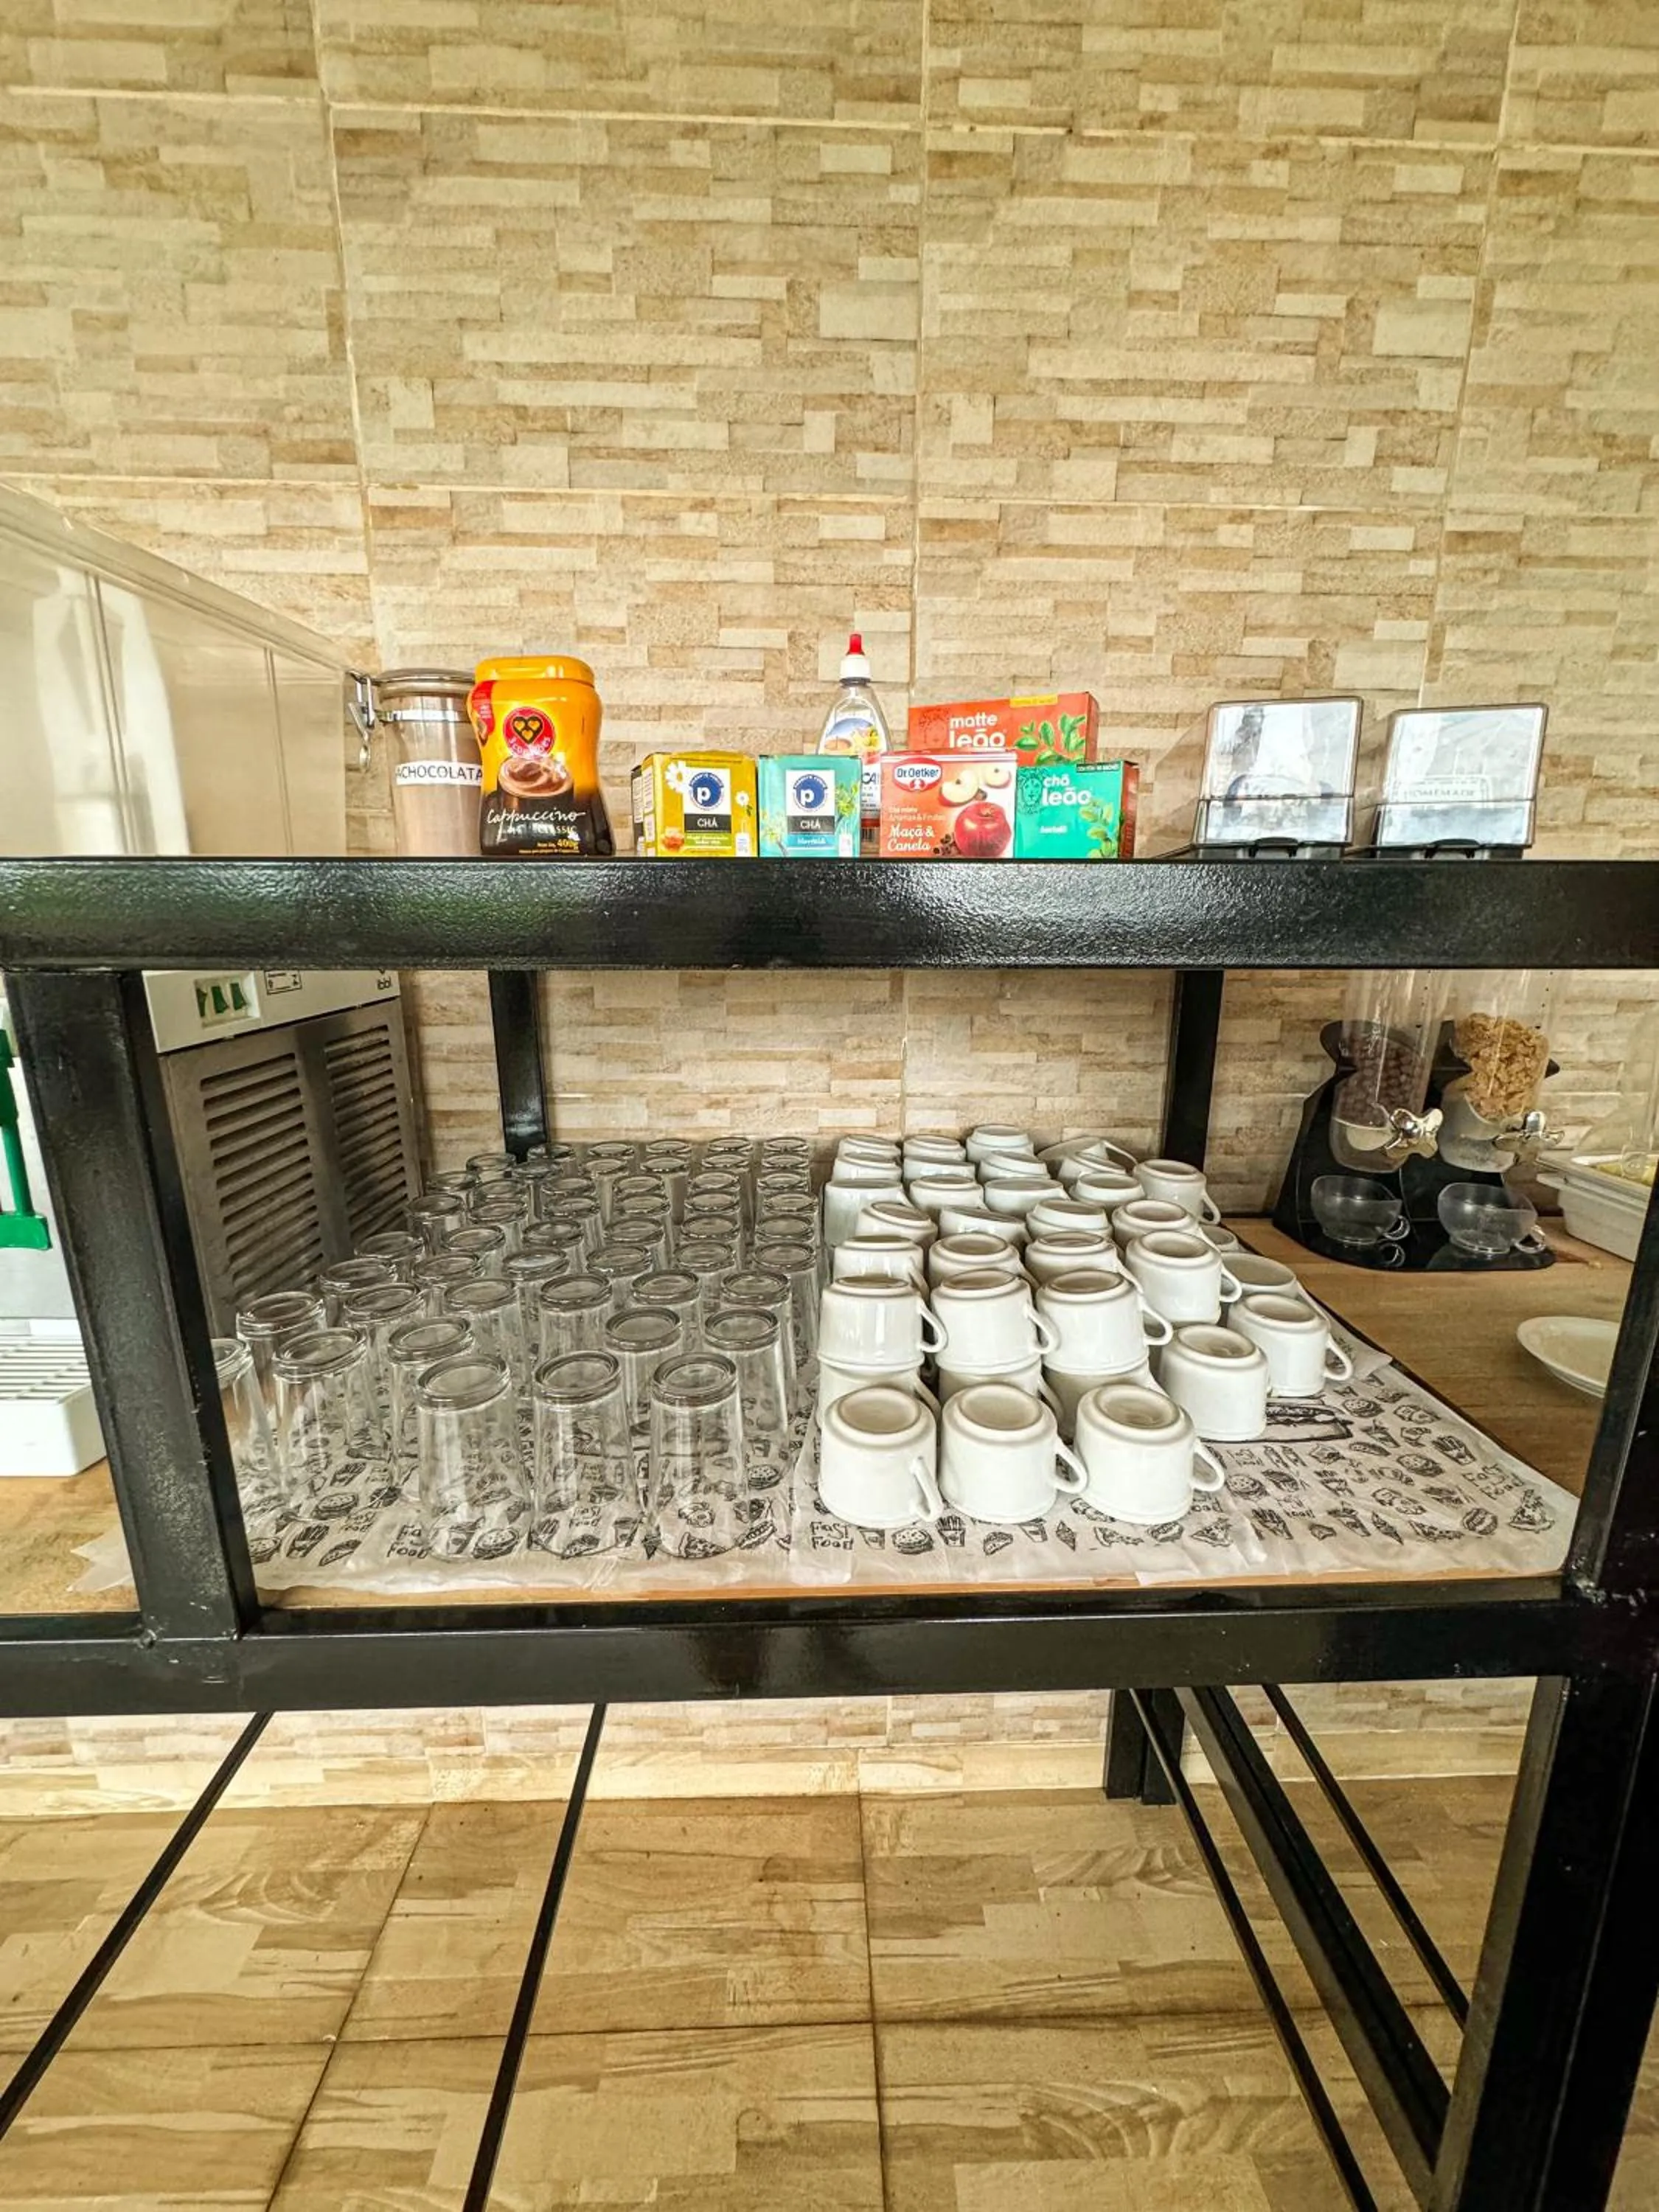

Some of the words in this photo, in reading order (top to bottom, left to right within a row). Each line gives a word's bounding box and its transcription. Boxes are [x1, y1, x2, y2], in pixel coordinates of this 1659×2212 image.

[950, 712, 998, 728] matte
[949, 727, 1006, 748] leão
[1042, 787, 1091, 806] leão
[486, 807, 586, 845] Cappuccino
[697, 817, 718, 827] CHÁ
[800, 818, 821, 830] CHÁ
[889, 823, 923, 839] Maçã
[925, 825, 935, 837] &
[887, 838, 930, 852] Canela
